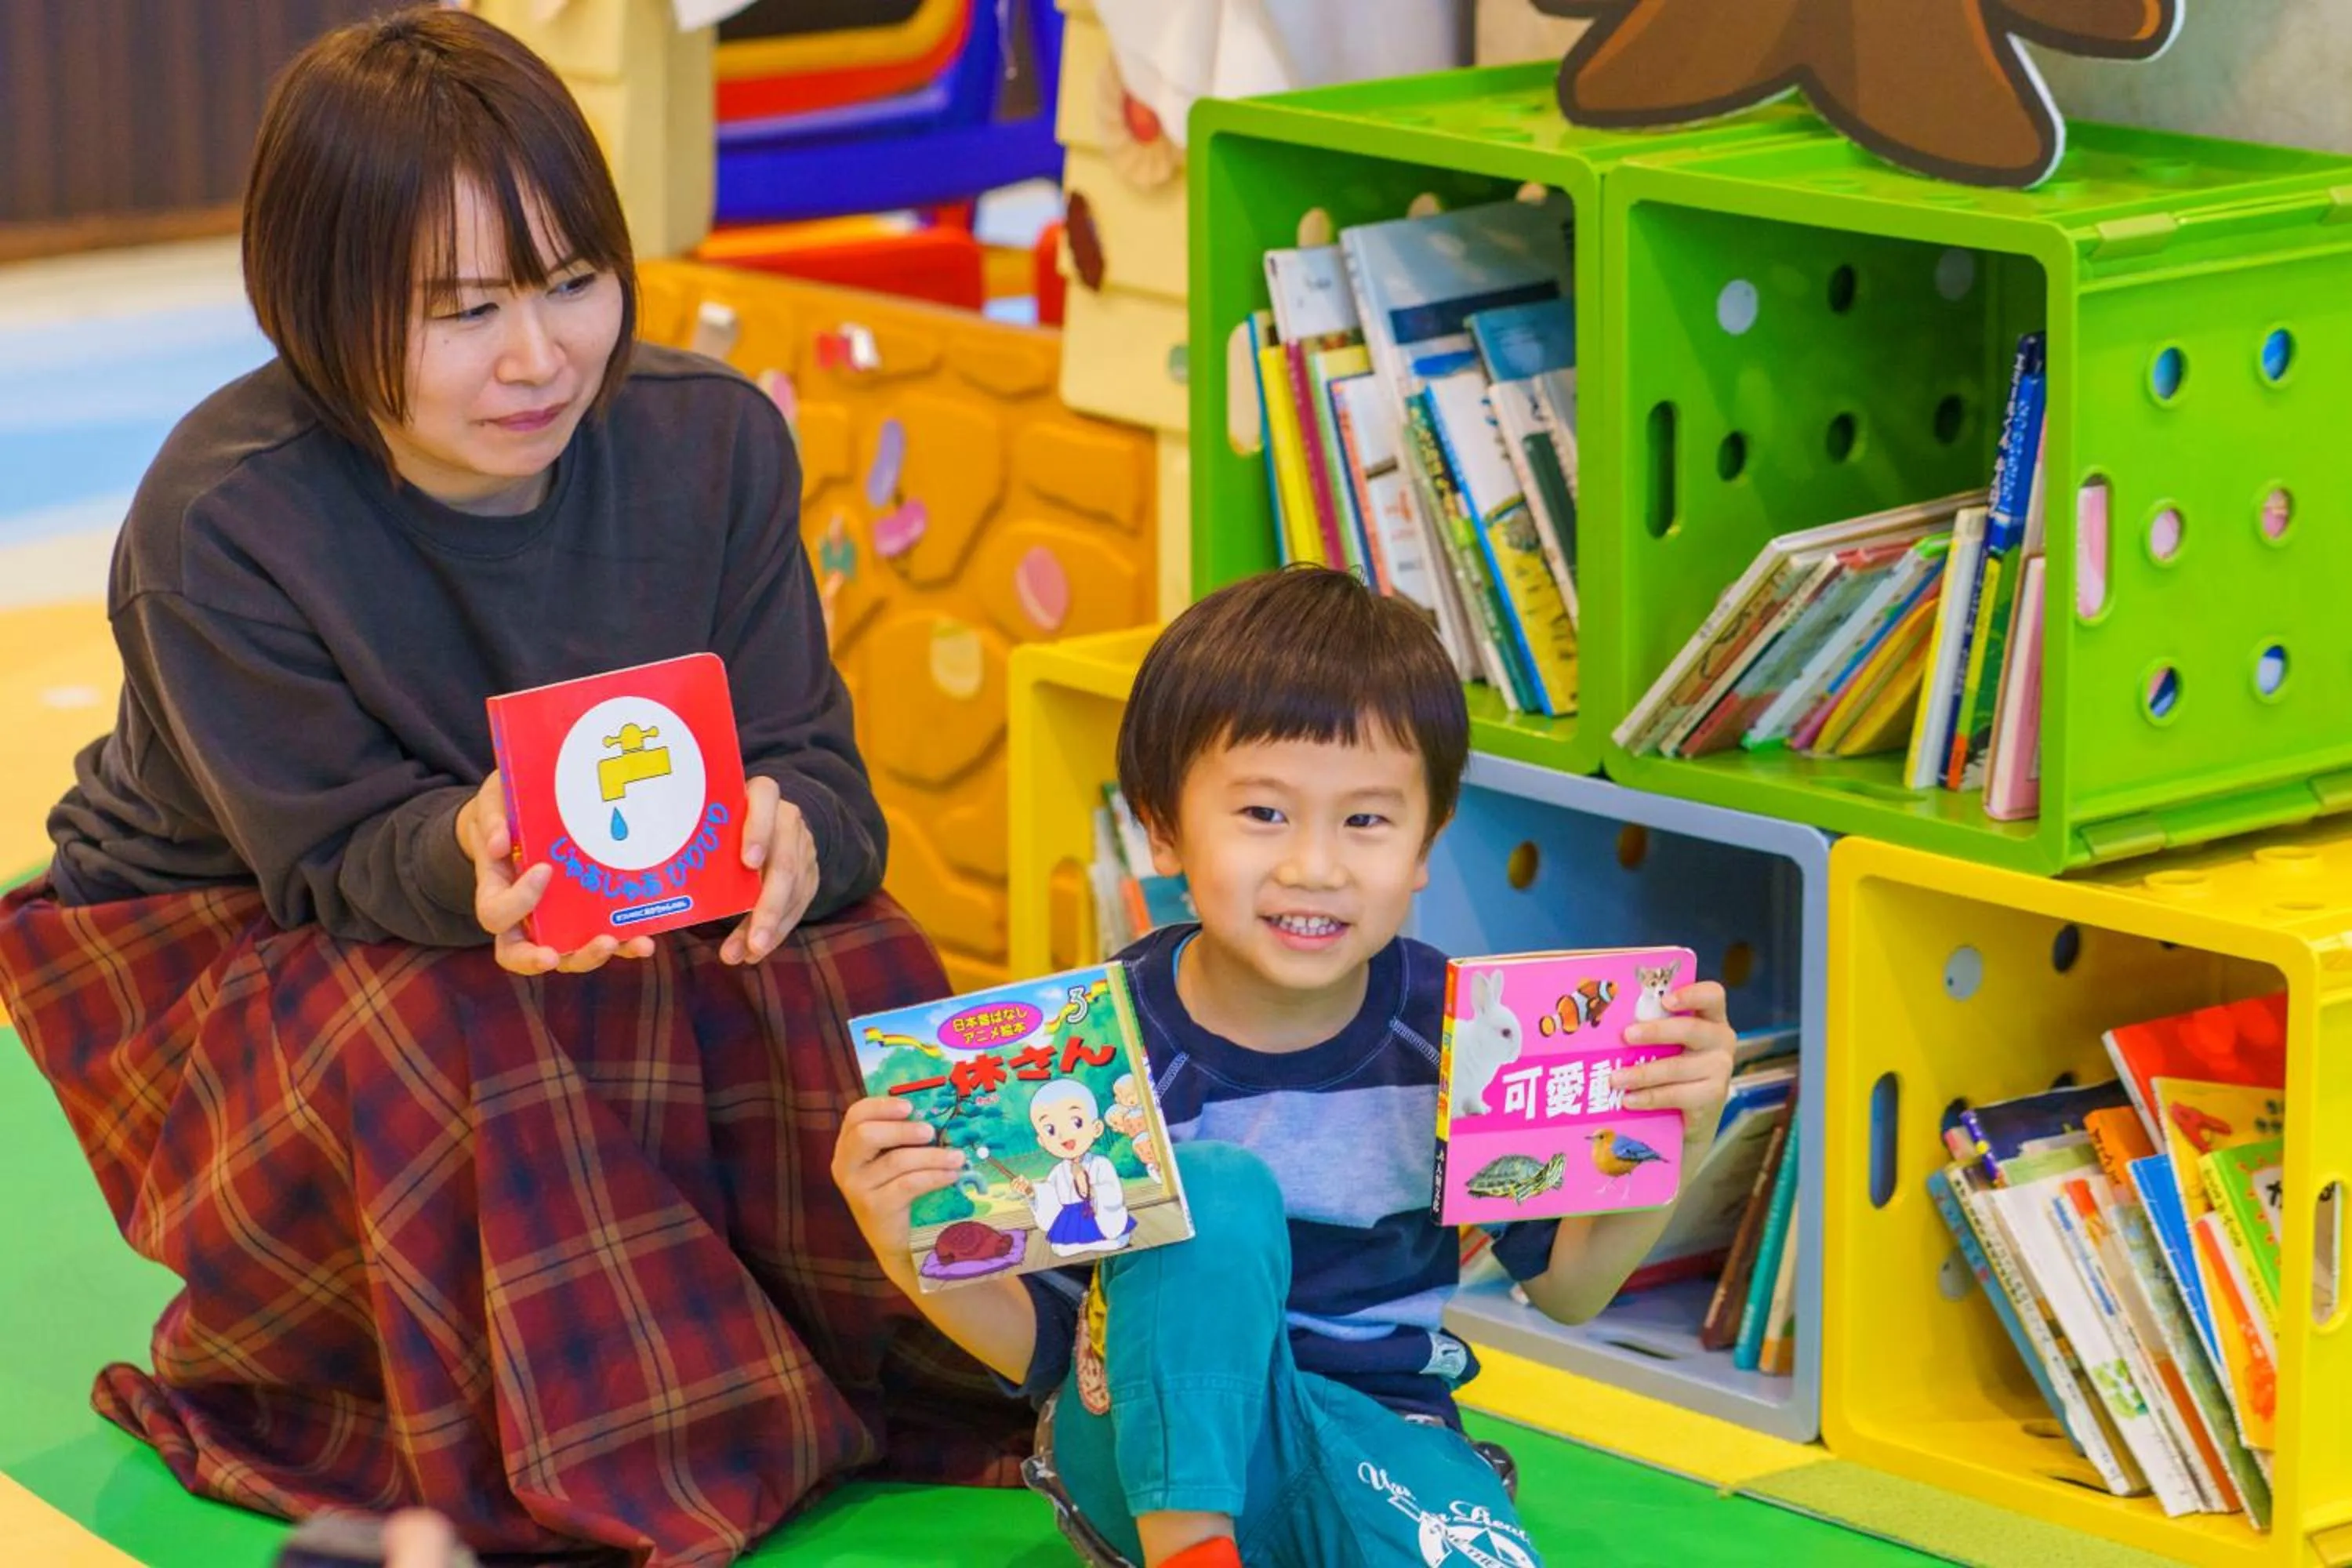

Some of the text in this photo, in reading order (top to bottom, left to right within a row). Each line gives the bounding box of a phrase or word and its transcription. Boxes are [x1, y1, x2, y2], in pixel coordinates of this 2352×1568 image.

[664, 801, 730, 887] びりびり
[1067, 985, 1089, 1024] 3
[888, 1036, 1116, 1097] 一休さん
[1502, 1054, 1657, 1121] 可愛動
